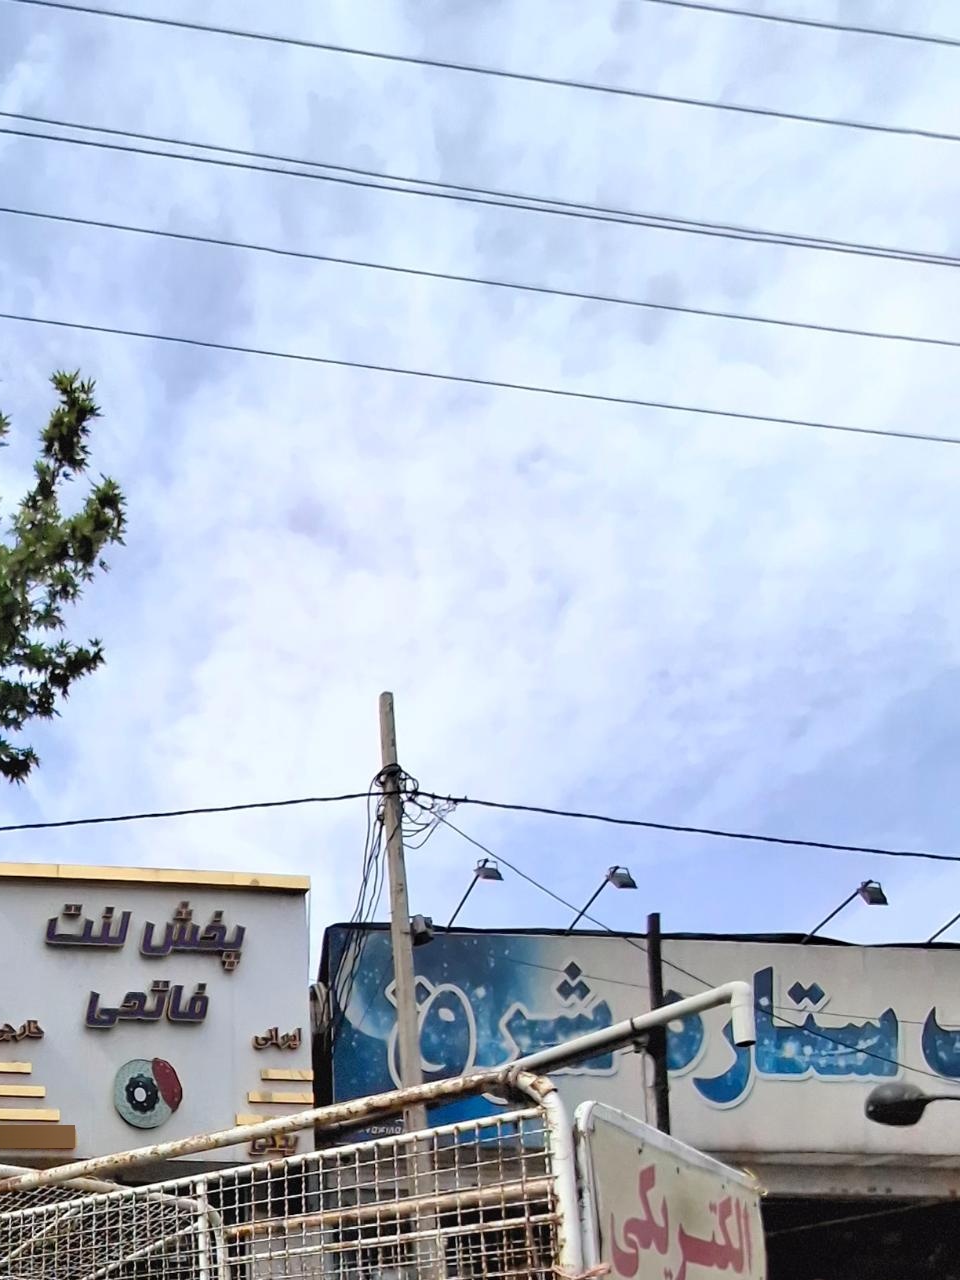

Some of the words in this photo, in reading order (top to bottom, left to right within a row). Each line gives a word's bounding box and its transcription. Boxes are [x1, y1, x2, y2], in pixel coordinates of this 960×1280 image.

[44, 903, 132, 949] لنت
[140, 900, 246, 971] پخش
[85, 979, 210, 1029] فاتحی
[251, 1026, 303, 1051] ایرانی
